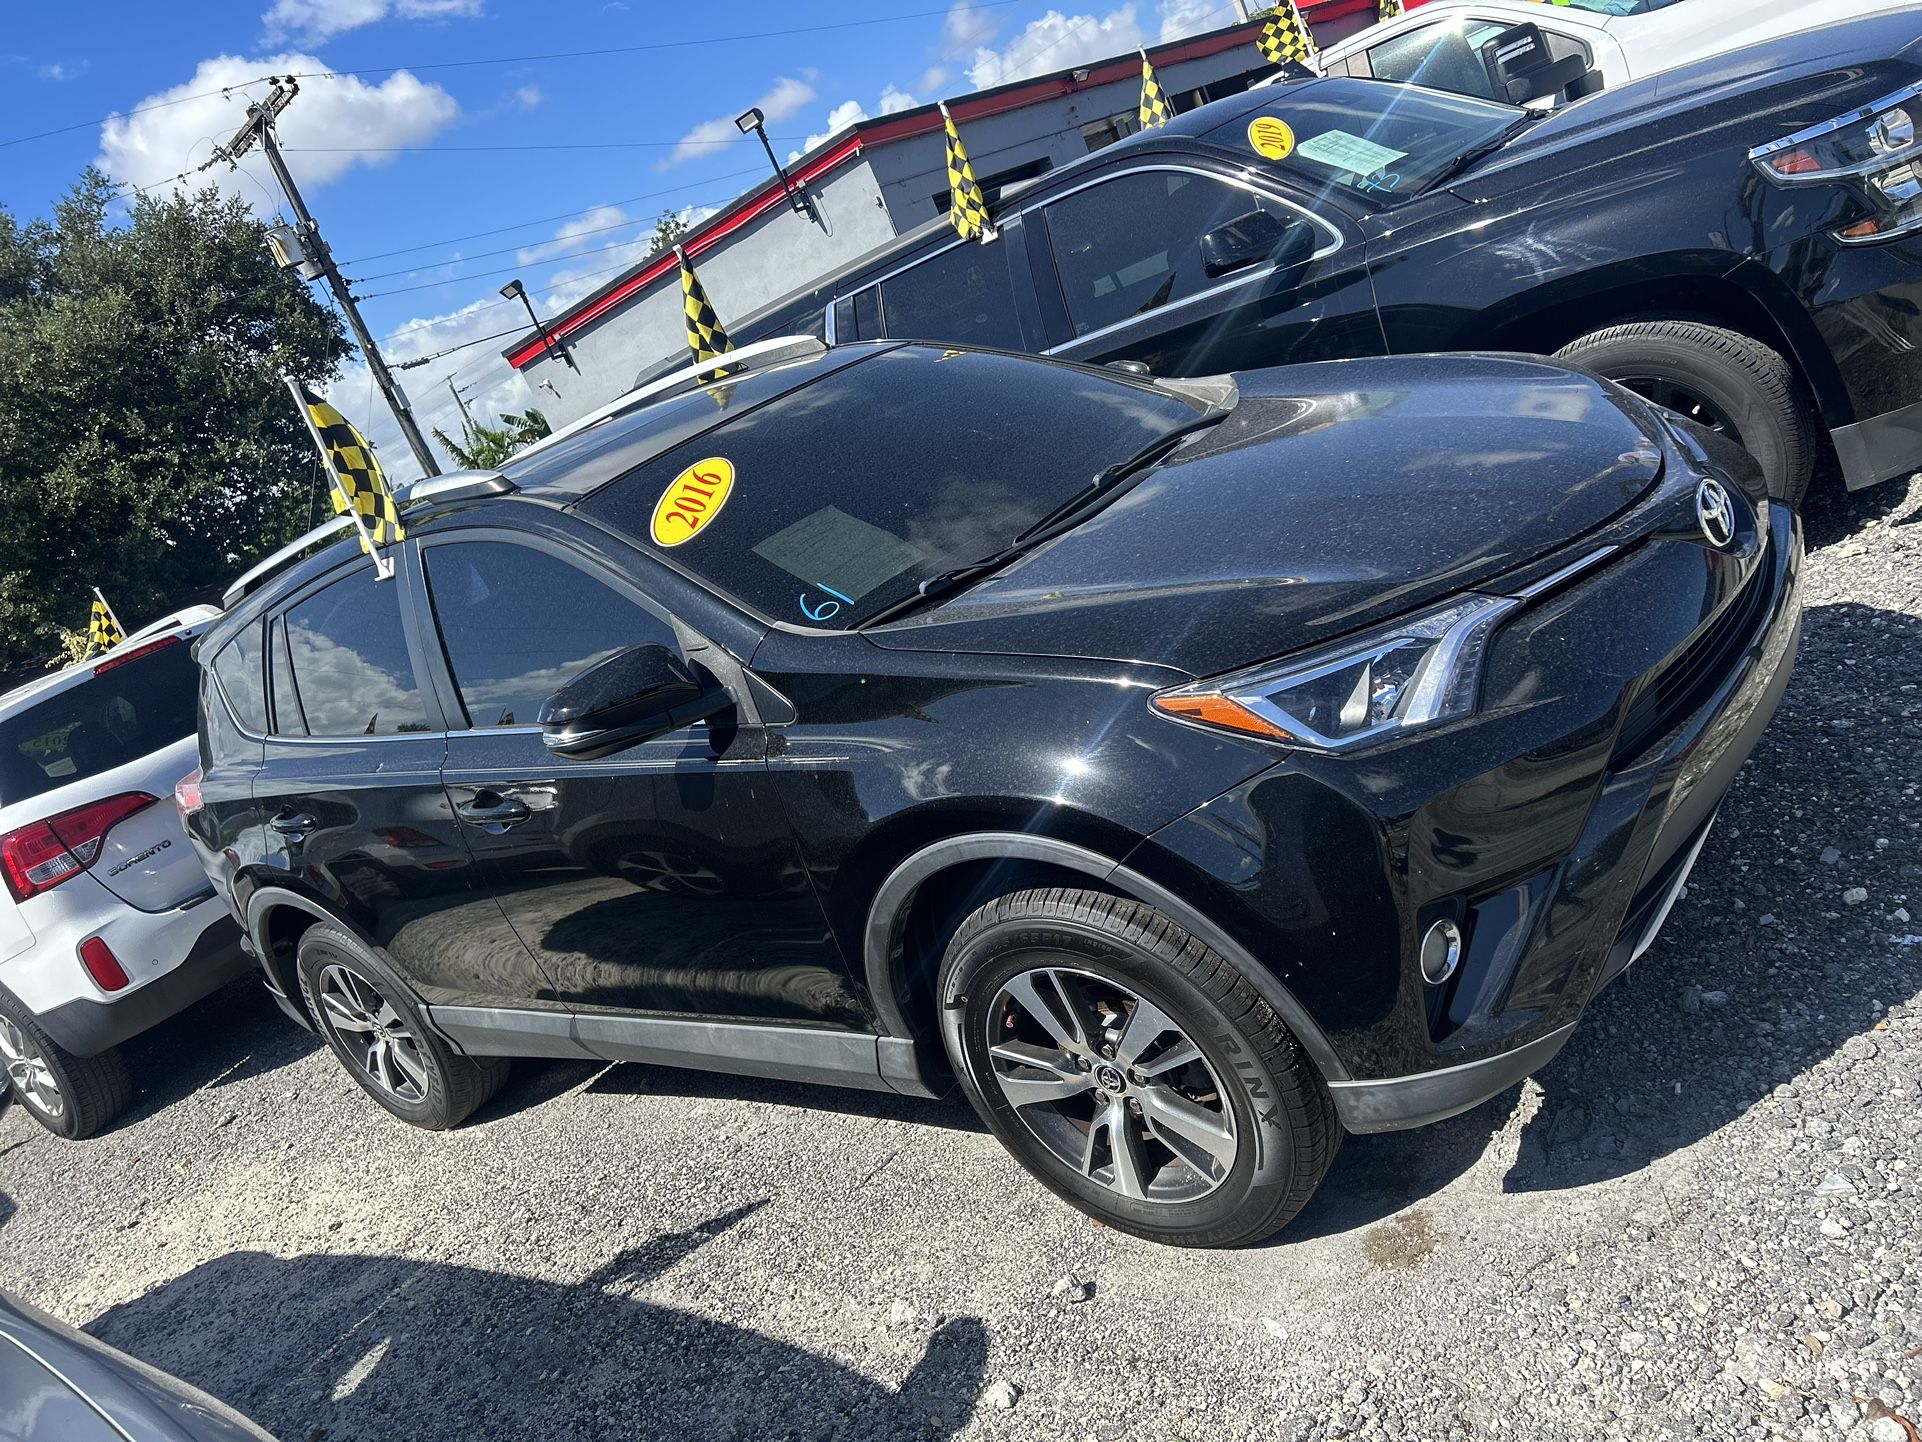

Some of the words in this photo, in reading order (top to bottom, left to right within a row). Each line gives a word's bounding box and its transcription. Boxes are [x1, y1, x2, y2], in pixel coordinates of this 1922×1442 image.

[1256, 123, 1286, 151] 2019
[666, 469, 722, 530] 2016
[800, 582, 855, 621] 61
[107, 839, 172, 877] SORENTO
